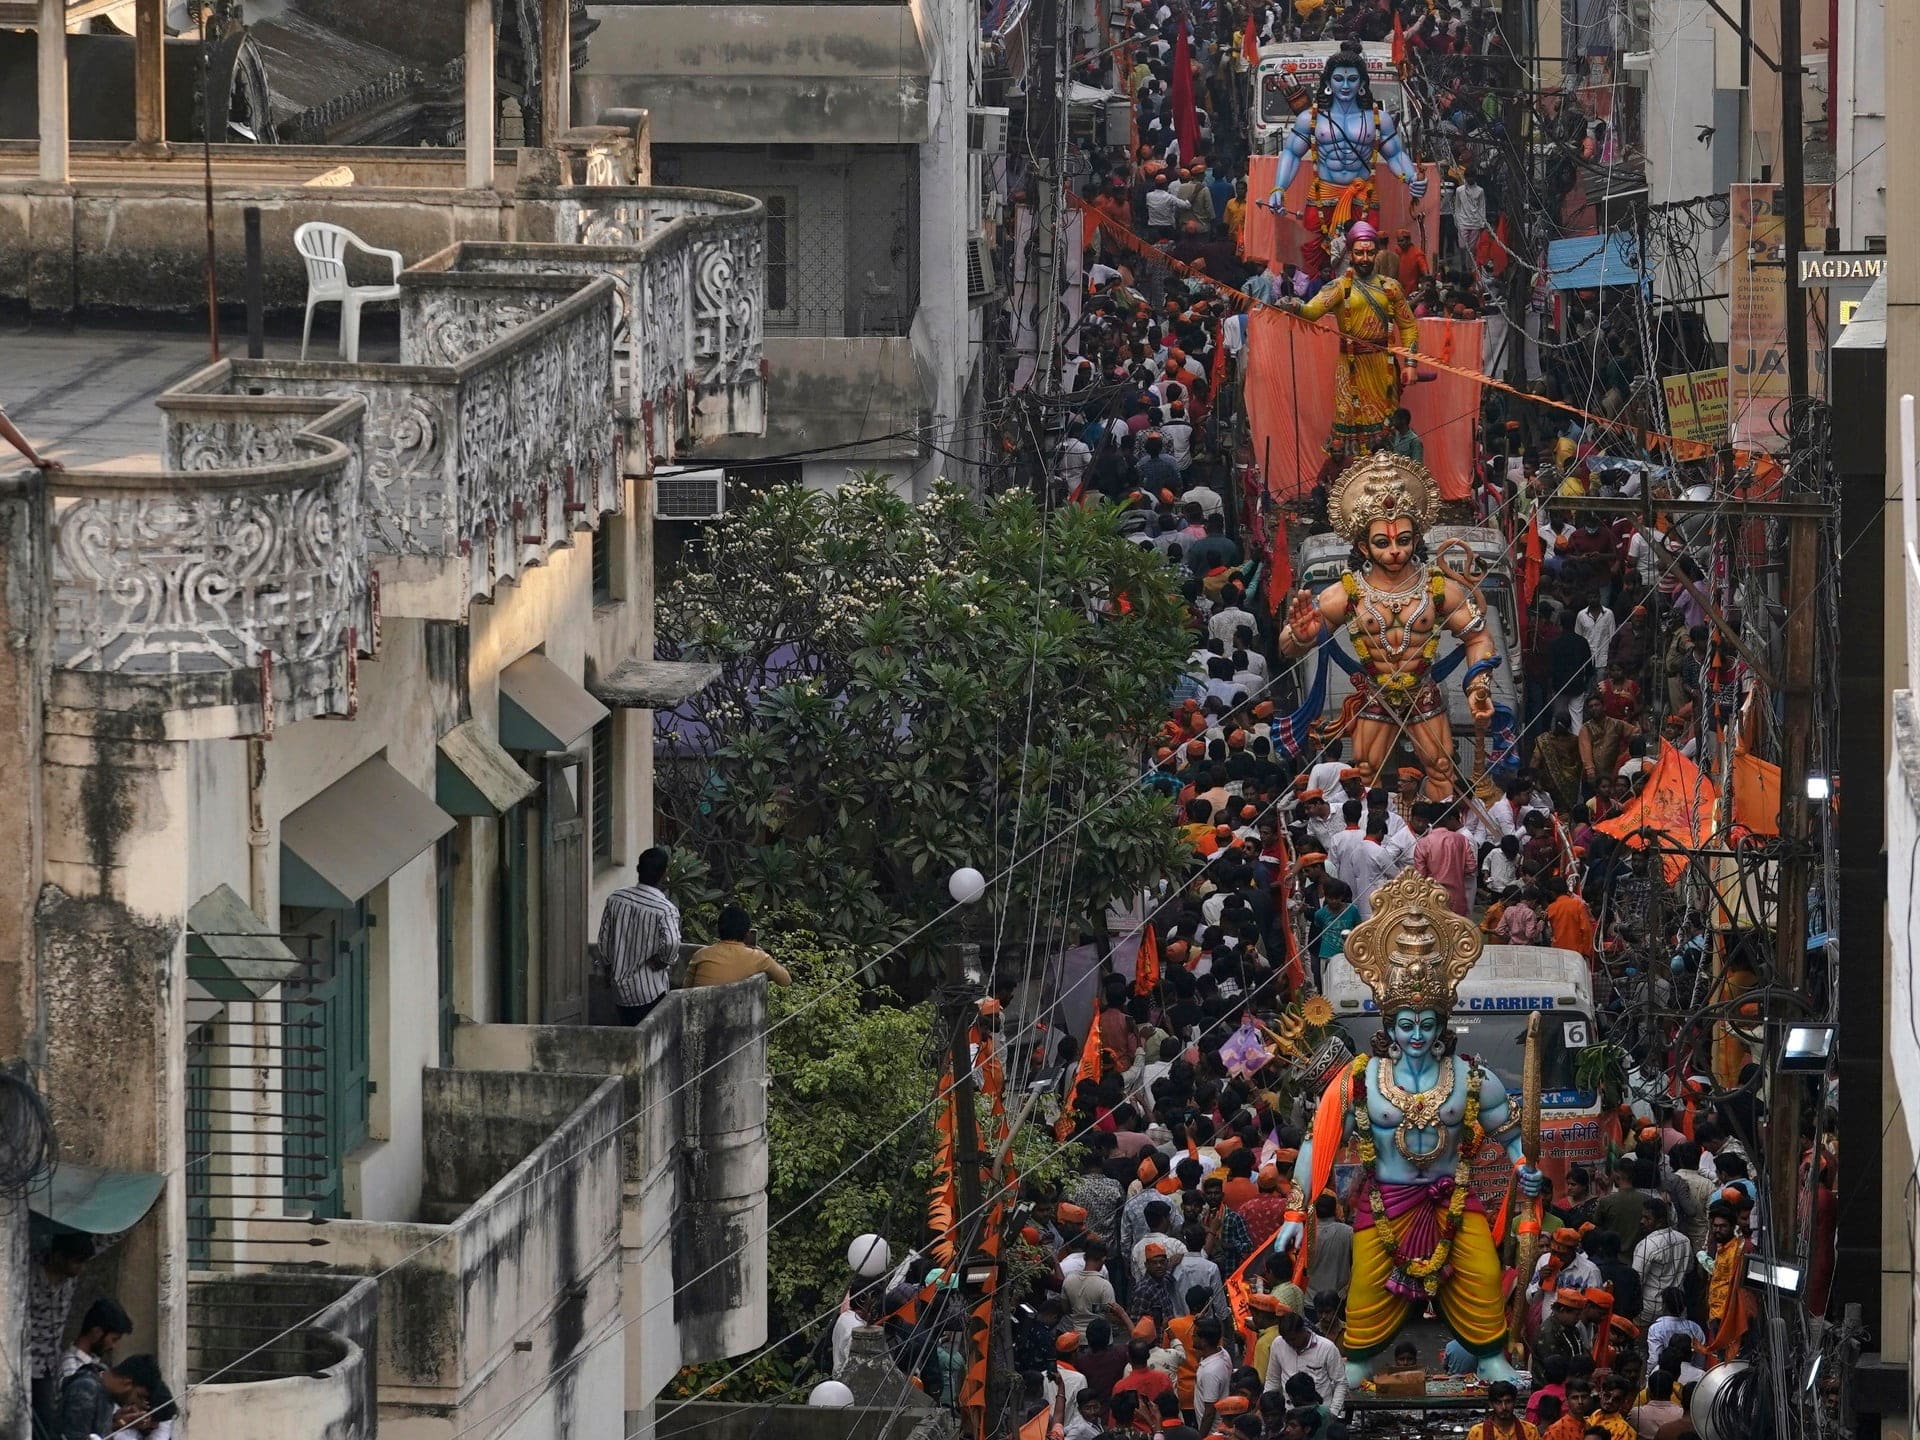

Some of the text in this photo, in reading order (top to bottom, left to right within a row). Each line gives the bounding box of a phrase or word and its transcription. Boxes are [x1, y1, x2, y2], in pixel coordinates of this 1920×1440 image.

[1280, 62, 1324, 70] GODS
[1801, 260, 1887, 282] JAGDAM
[1666, 385, 1691, 409] R.K.
[1470, 997, 1554, 1010] CARRIER
[1568, 1025, 1584, 1044] 6
